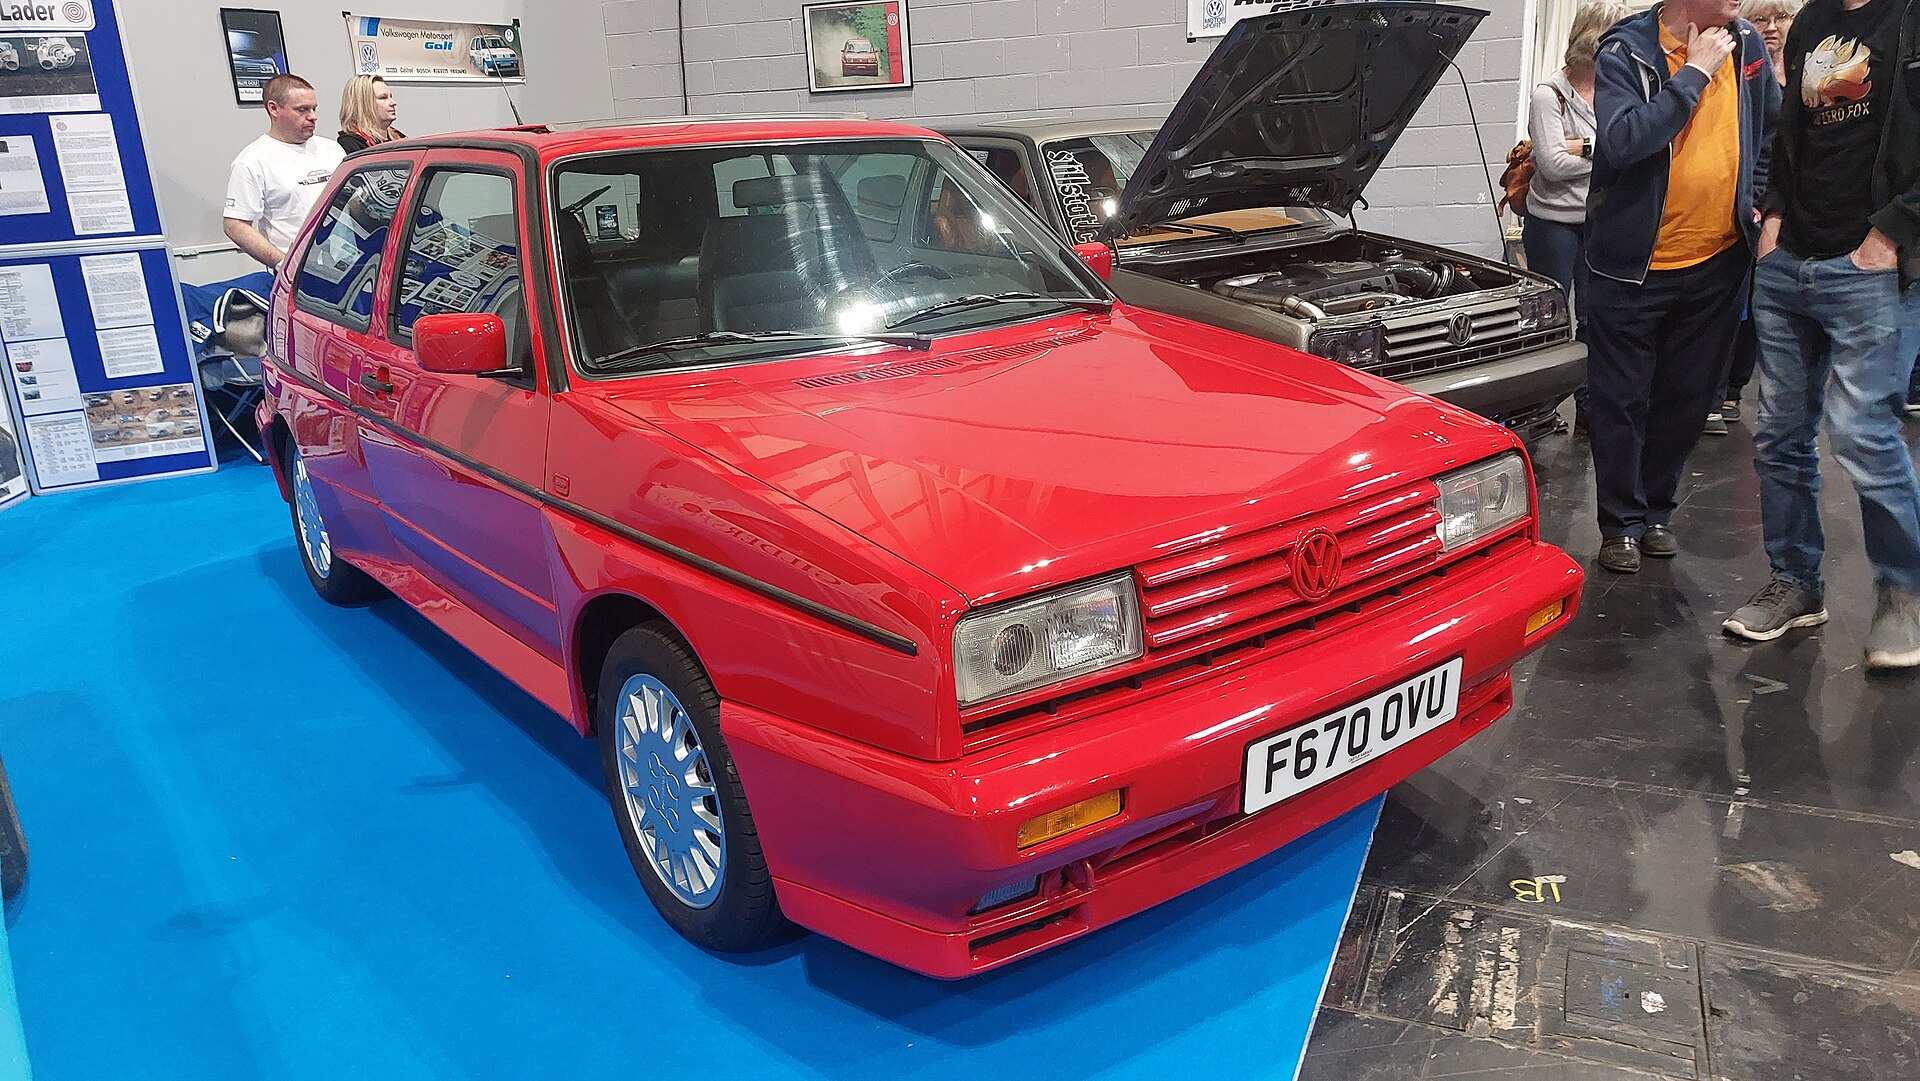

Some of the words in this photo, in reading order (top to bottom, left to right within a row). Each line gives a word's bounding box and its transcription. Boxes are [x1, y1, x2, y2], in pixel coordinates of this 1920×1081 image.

[0, 0, 55, 21] Lader
[380, 28, 419, 41] Volkswagen
[420, 31, 453, 41] Motorsport
[424, 41, 453, 50] Golf
[1821, 107, 1844, 125] ZERO
[1846, 101, 1870, 119] FOX
[1264, 706, 1371, 794] F670
[1380, 669, 1448, 742] OVU
